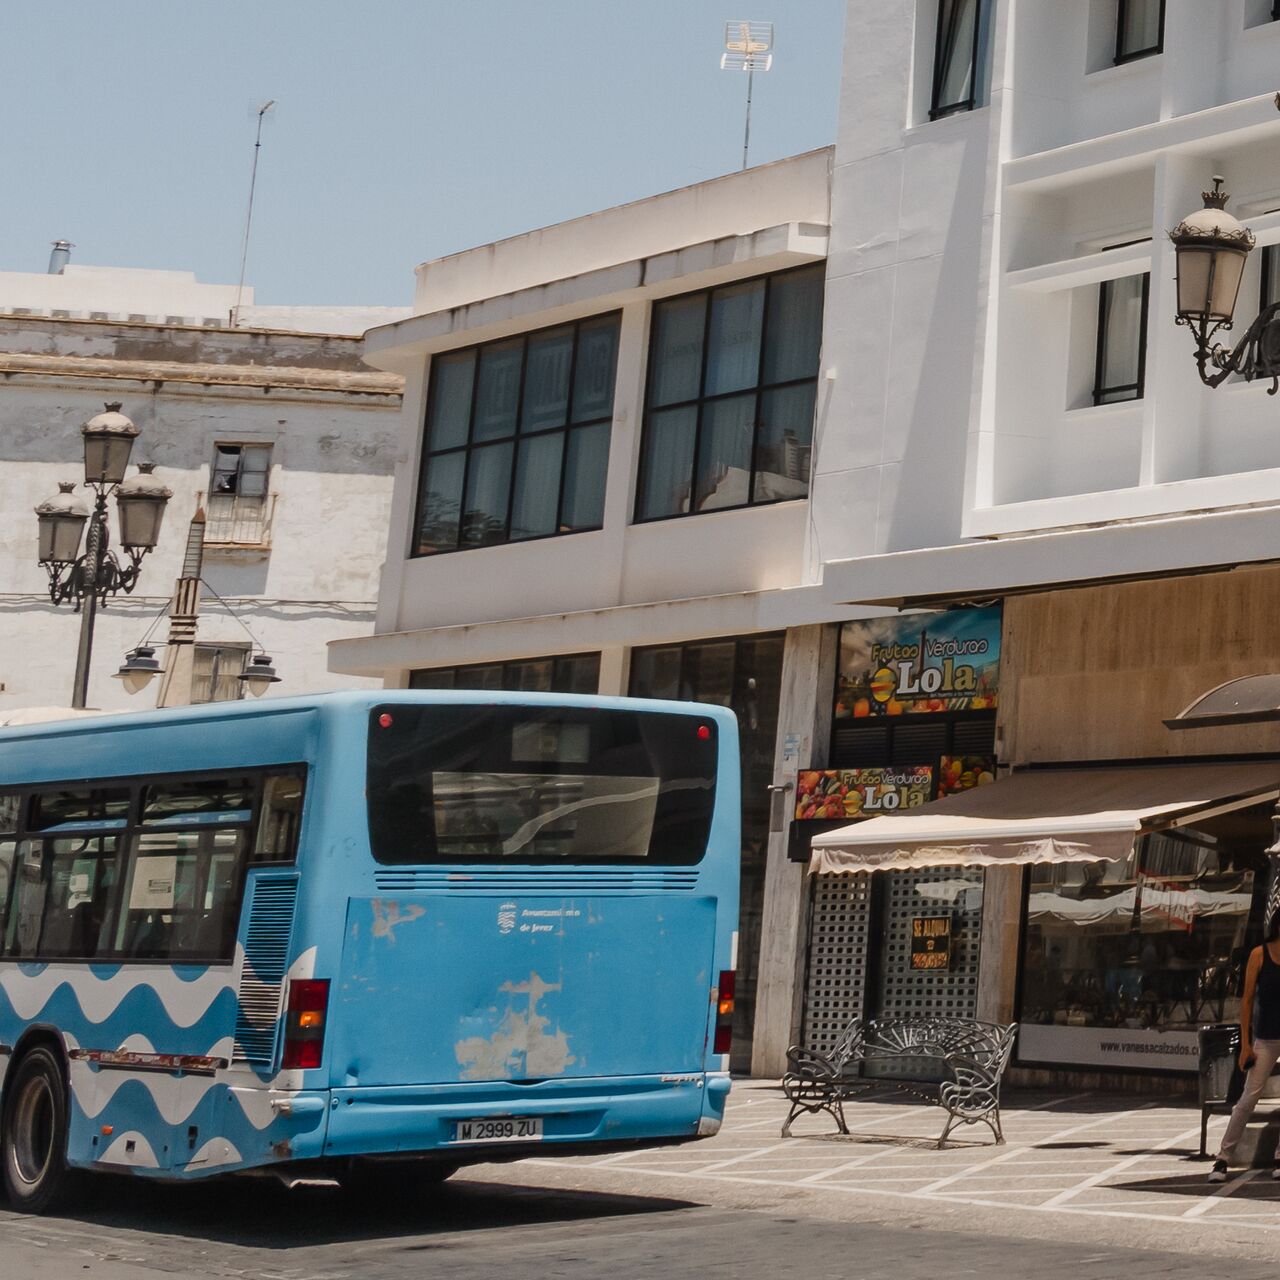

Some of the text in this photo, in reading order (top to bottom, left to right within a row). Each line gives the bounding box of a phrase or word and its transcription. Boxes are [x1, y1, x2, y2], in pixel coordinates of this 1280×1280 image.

[872, 636, 988, 661] Frutas Verduras
[895, 658, 977, 694] Lola
[843, 772, 929, 785] Frutas Verduras
[863, 786, 925, 810] Lola
[521, 909, 581, 917] Ayuntamino
[461, 1121, 536, 1140] M 2999 ZU
